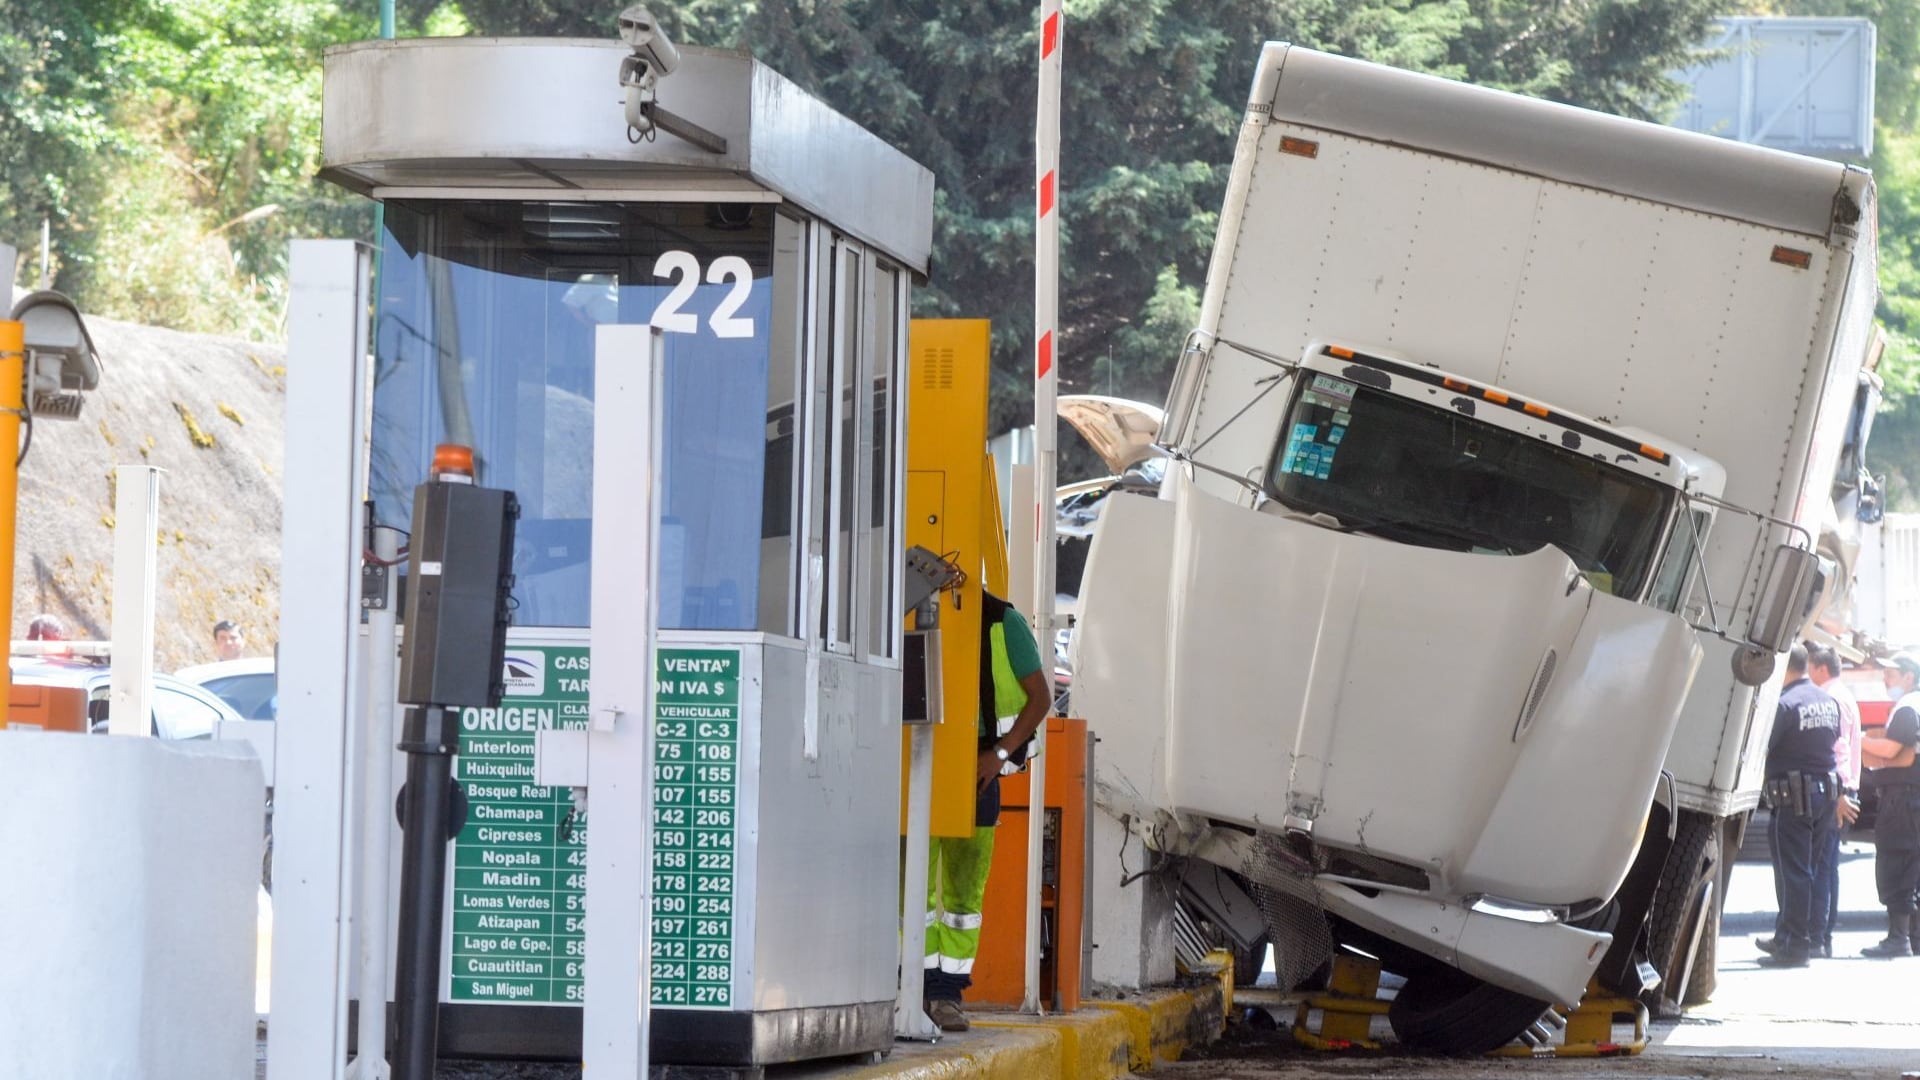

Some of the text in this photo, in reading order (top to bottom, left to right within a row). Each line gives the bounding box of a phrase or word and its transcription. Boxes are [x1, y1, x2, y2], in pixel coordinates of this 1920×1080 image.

[651, 249, 754, 339] 22
[680, 681, 708, 694] IVA
[714, 681, 724, 696] $
[463, 707, 553, 731] ORIGEN
[564, 705, 730, 717] CLA VEHICULAR
[656, 723, 686, 737] C-2
[699, 723, 730, 737] C-3
[659, 744, 680, 758] 75
[698, 744, 731, 759] 108
[654, 766, 685, 780] 107
[698, 767, 730, 781] 155
[468, 784, 517, 799] Bosque
[522, 785, 551, 798] Real
[654, 788, 684, 802] 107
[697, 789, 730, 803] 155
[476, 805, 730, 825] Chamapa 142 206
[478, 828, 542, 842] Cipreses
[653, 831, 685, 846] 150
[697, 833, 731, 847] 214
[482, 851, 540, 866] Nopala
[654, 853, 686, 867] 158
[698, 854, 730, 869] 222
[483, 872, 541, 886] Madin
[654, 876, 685, 890] 178
[697, 877, 730, 891] 242
[463, 894, 503, 907] Lomas
[508, 896, 550, 909] Verdes
[653, 897, 685, 912] 190
[697, 899, 730, 913] 254
[478, 915, 540, 930] Atizapan
[653, 919, 685, 934] 197
[696, 921, 728, 935] 261
[465, 937, 496, 951] Lago
[501, 938, 516, 950] de
[521, 938, 550, 953] Gpe.
[652, 942, 685, 957] 212
[696, 944, 729, 958] 276
[468, 959, 543, 974] Cuautitlan
[652, 964, 685, 979] 224
[696, 966, 729, 980] 288
[472, 982, 494, 995] San
[497, 982, 533, 997] Miguel
[651, 987, 685, 1001] 212
[696, 987, 728, 1002] 276
